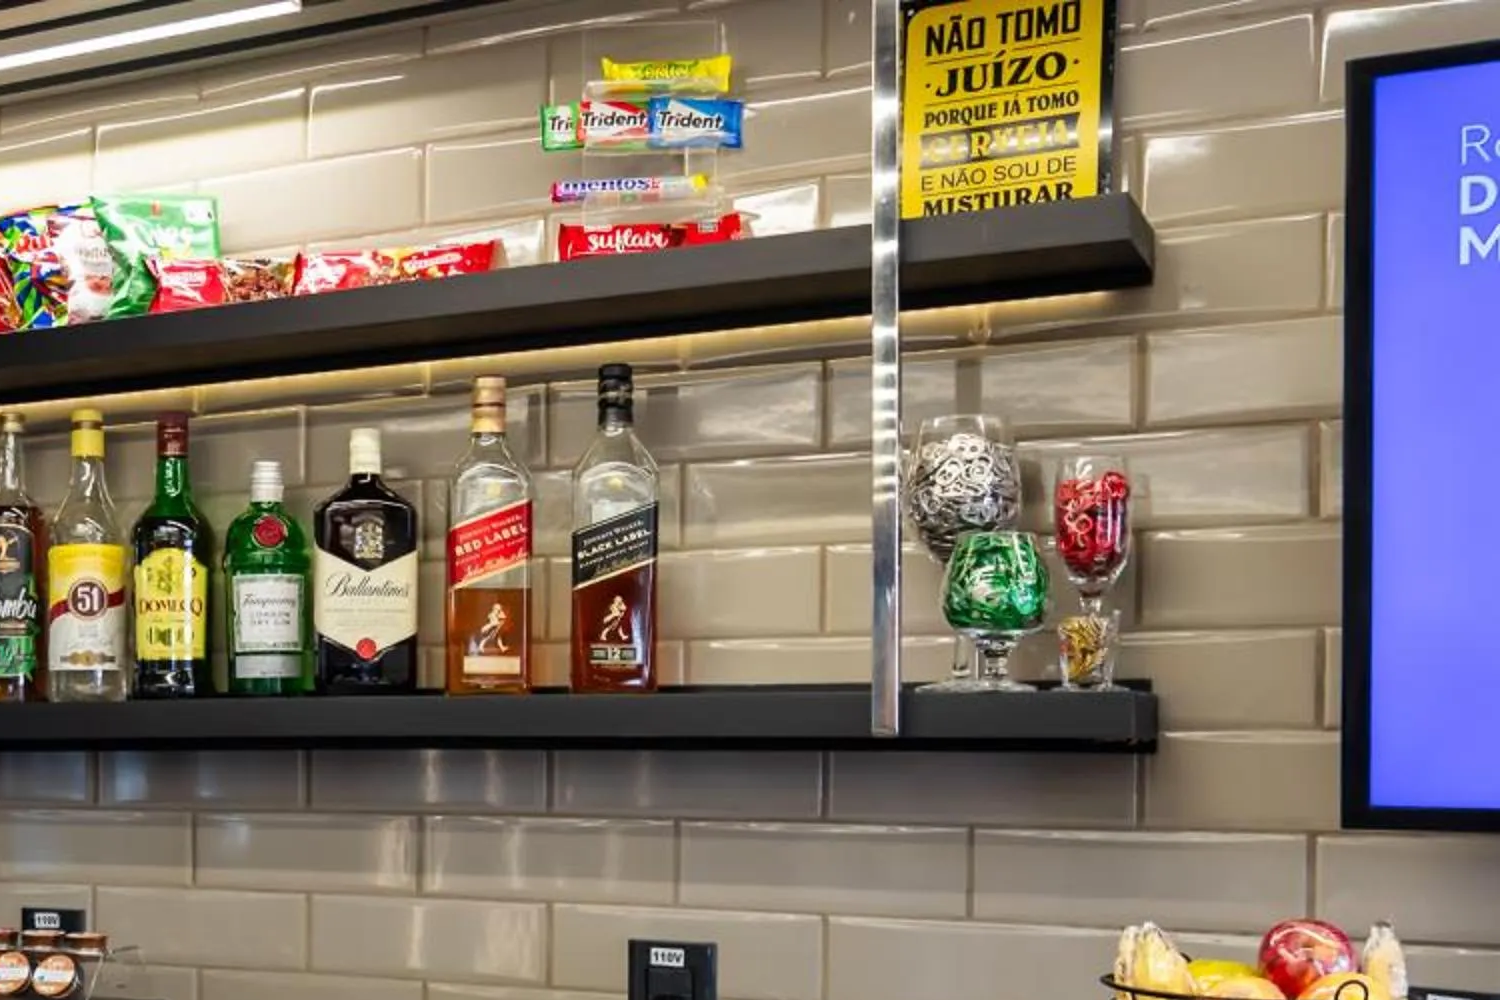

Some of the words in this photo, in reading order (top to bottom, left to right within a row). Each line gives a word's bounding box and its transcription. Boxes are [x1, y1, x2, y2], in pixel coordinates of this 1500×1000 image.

[925, 12, 987, 57] NÃO
[996, 1, 1082, 44] TOMO
[935, 49, 1068, 97] JUÍZO
[581, 112, 648, 128] Trident
[659, 111, 724, 129] Trident
[923, 103, 998, 128] PORQUE
[1002, 94, 1022, 118] JÁ
[1026, 90, 1080, 113] TOMO
[927, 119, 1071, 163] CERVEJA
[1460, 124, 1500, 166] R
[562, 178, 651, 192] mentos
[920, 175, 933, 192] E
[940, 168, 987, 189] NÃO
[993, 158, 1040, 182] SOU
[1047, 156, 1077, 175] DE
[923, 181, 1074, 217] MISTURAR
[455, 539, 482, 557] RED
[484, 523, 528, 545] LABEL
[577, 540, 613, 559] BLACK
[615, 528, 651, 546] LABEL
[77, 586, 100, 612] 51
[653, 951, 683, 963] 110V
